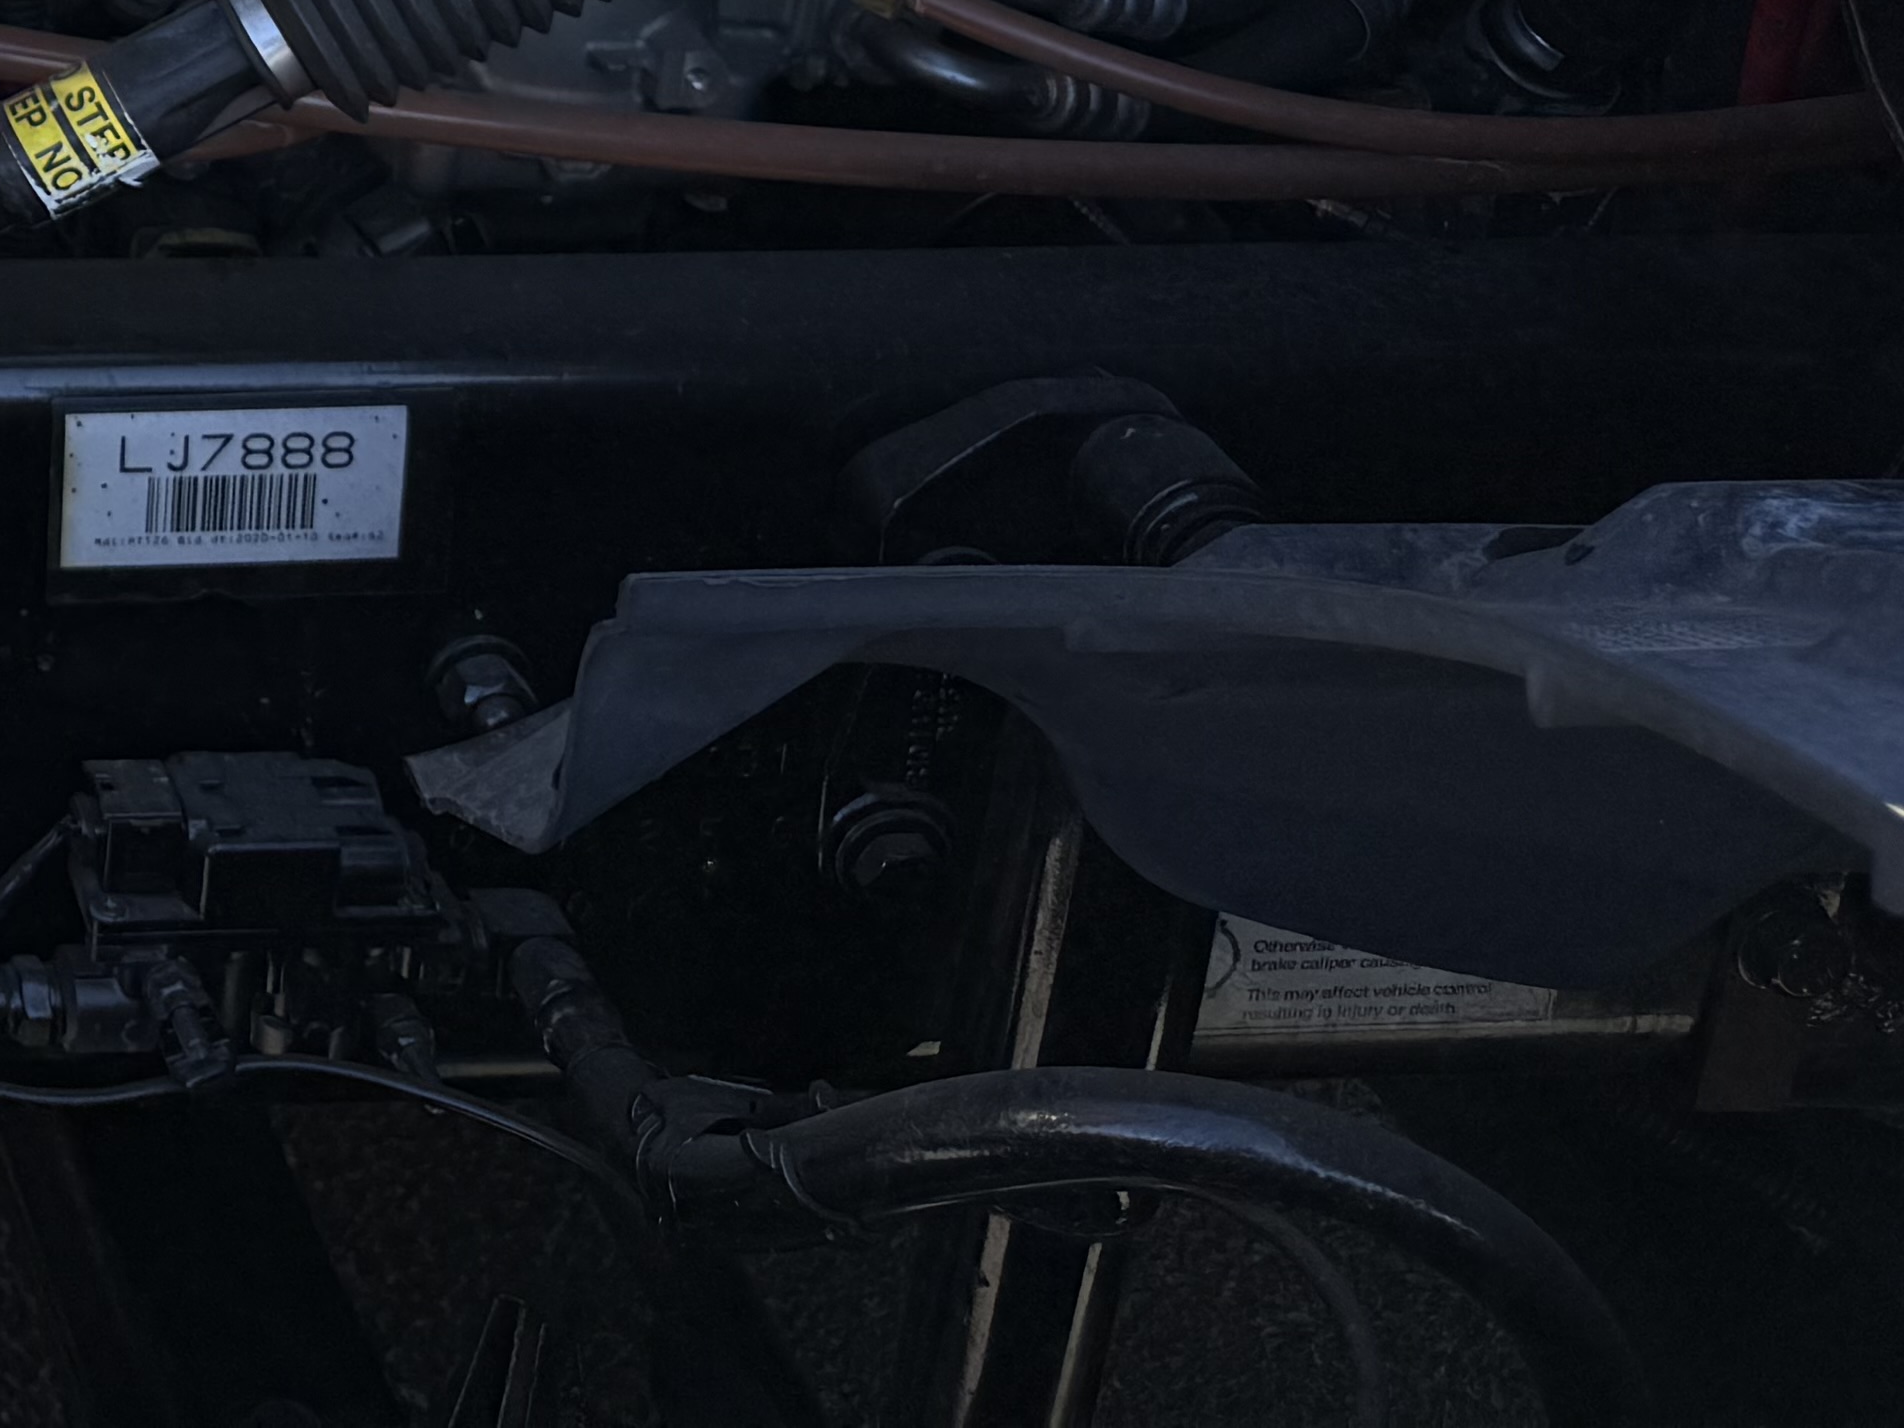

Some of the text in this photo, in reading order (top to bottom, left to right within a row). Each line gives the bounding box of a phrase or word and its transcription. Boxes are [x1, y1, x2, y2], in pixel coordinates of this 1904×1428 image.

[8, 92, 83, 191] EP NO
[1252, 957, 1355, 972] brake caliper
[1247, 988, 1280, 1001] This
[1283, 989, 1316, 1002] may
[1321, 986, 1370, 1000] affect
[1374, 985, 1430, 998] vehicle
[1338, 1003, 1384, 1019] injury
[1388, 1005, 1405, 1016] or
